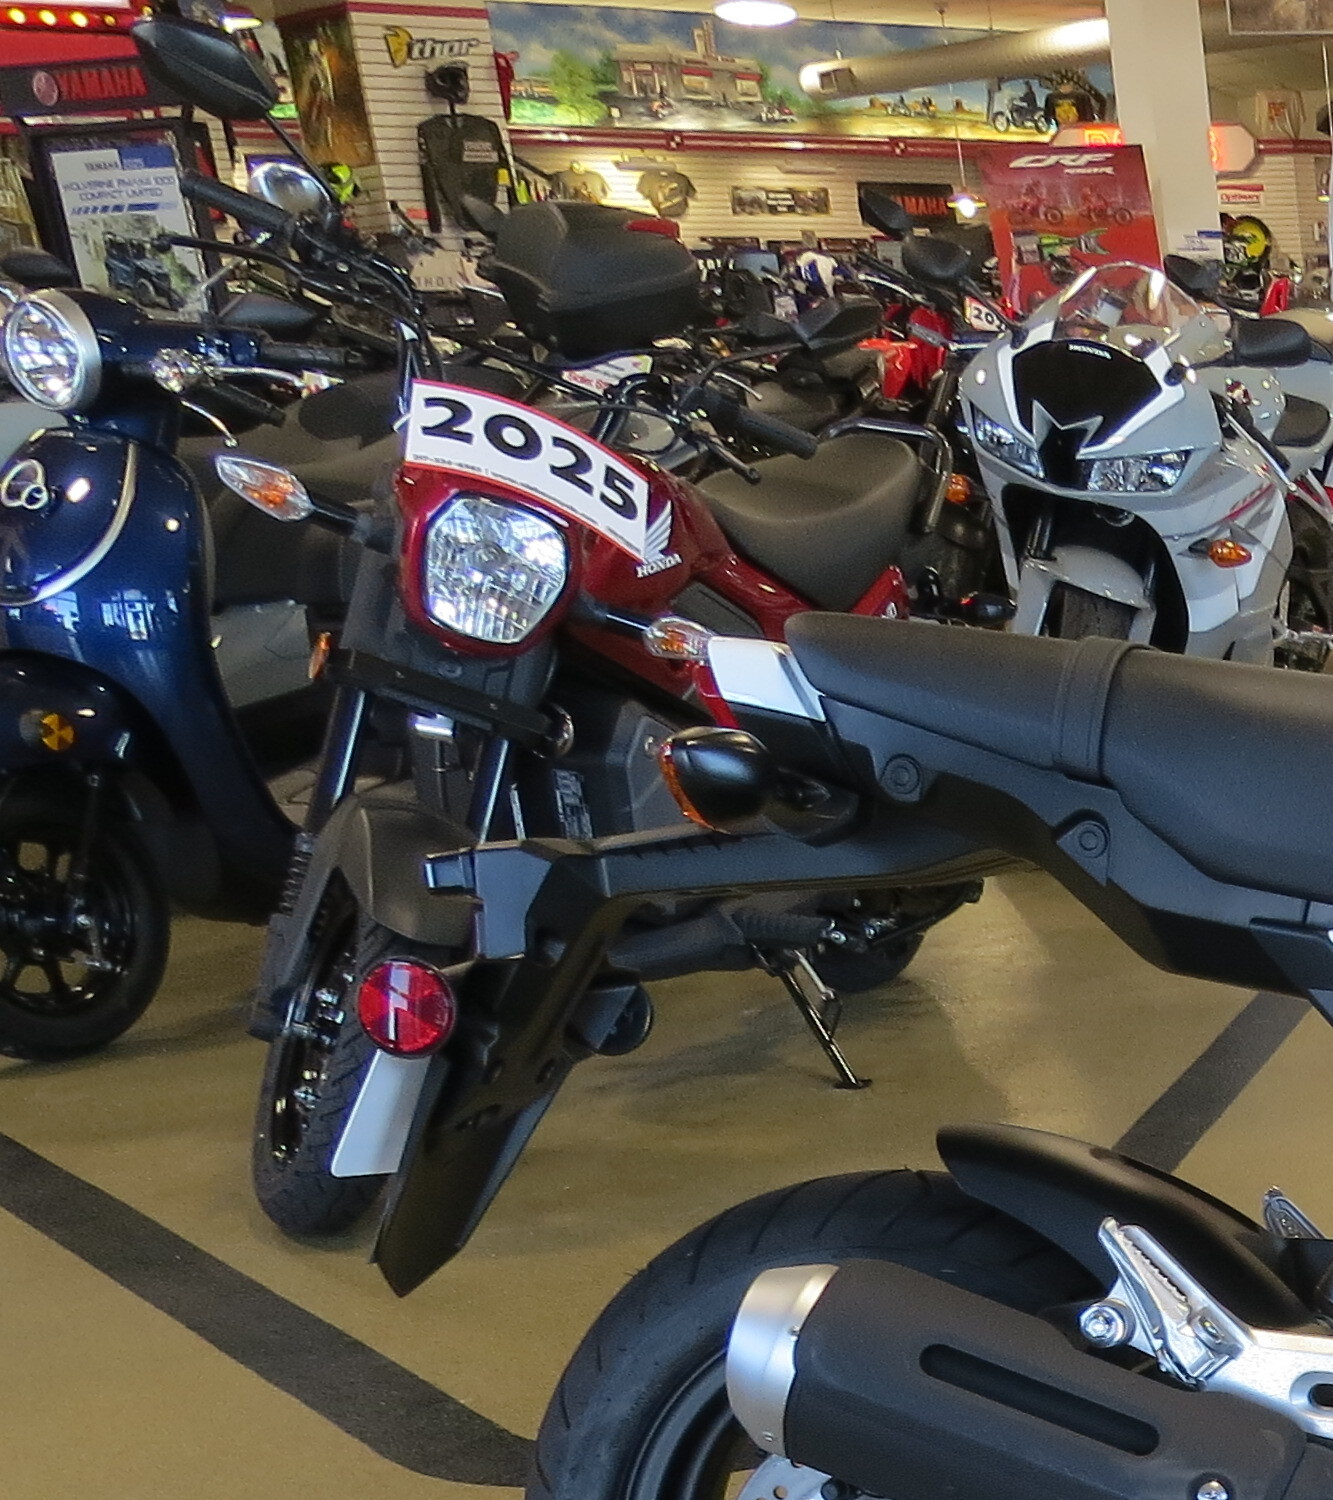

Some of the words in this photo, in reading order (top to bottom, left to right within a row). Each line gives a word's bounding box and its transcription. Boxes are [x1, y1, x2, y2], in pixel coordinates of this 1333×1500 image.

[55, 66, 148, 100] YAMAHA
[1008, 154, 1113, 169] CRF
[1068, 344, 1112, 360] HONDA
[421, 397, 639, 521] 2025
[636, 553, 683, 578] HONDA
